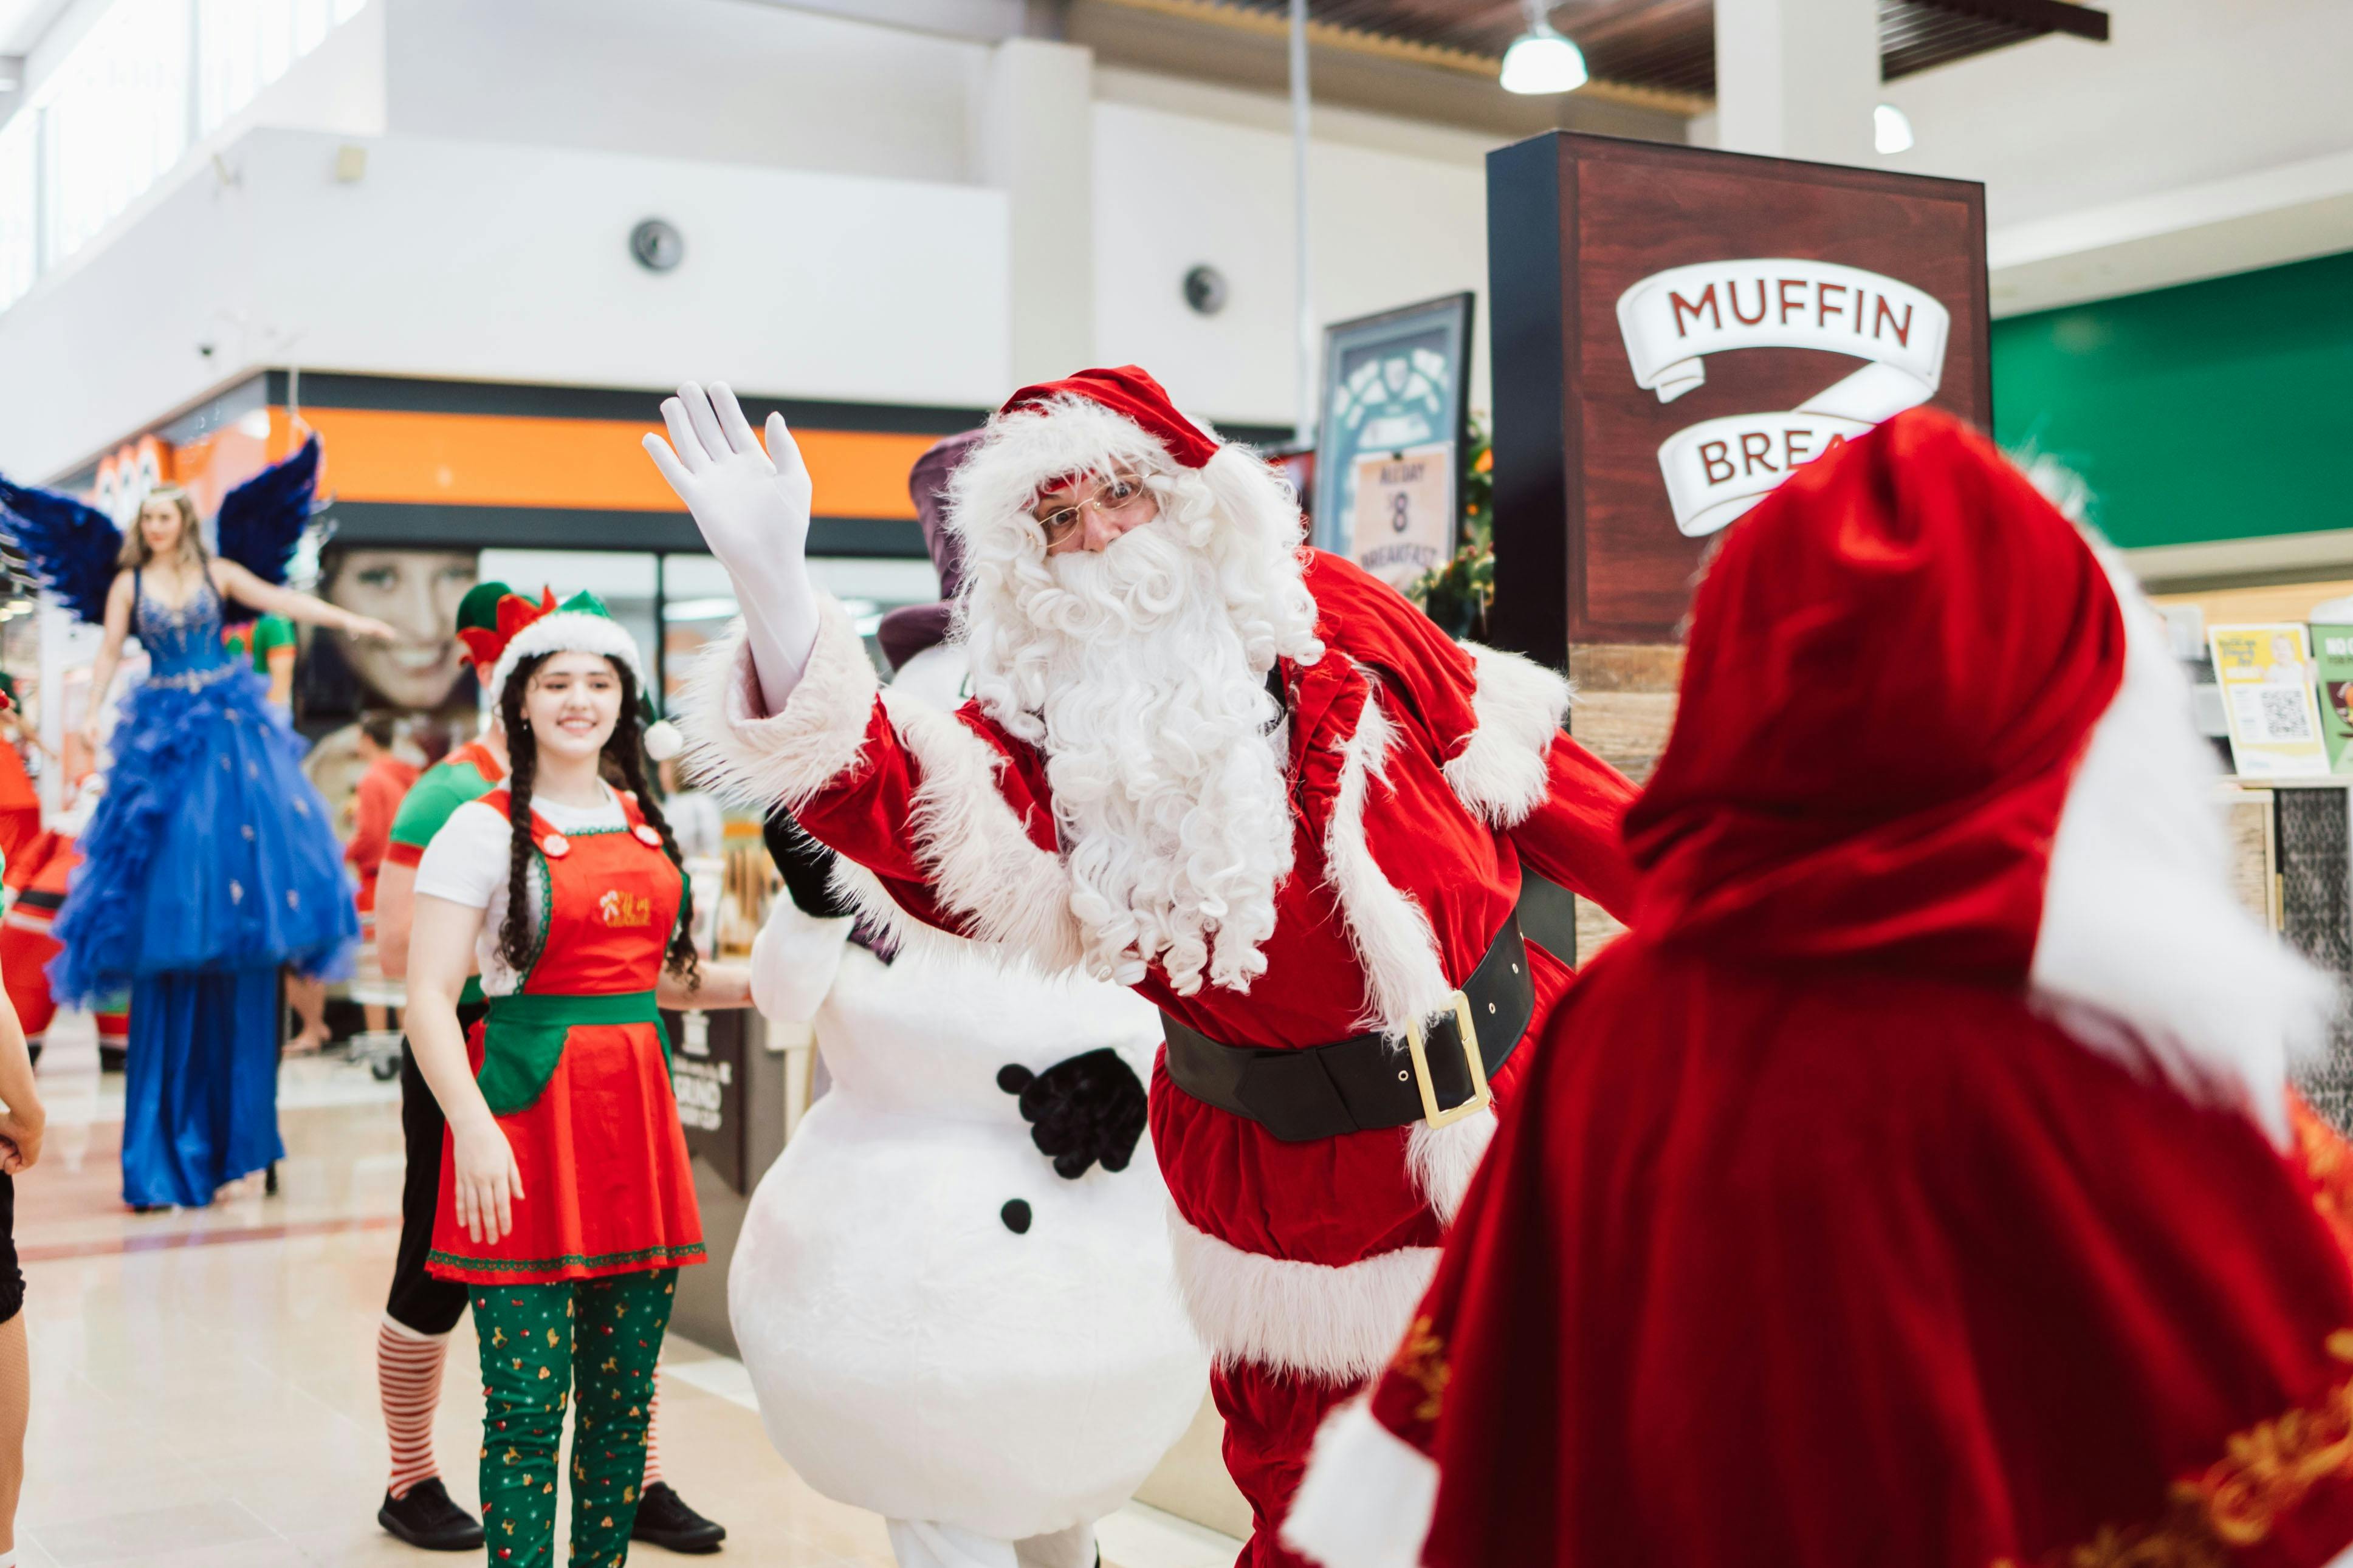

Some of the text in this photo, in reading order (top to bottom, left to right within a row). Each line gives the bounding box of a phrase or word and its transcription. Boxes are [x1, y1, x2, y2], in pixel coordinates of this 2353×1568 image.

[1668, 279, 1912, 348] MUFFIN
[1403, 462, 1425, 482] DAY
[1361, 544, 1437, 569] BREAKFAST
